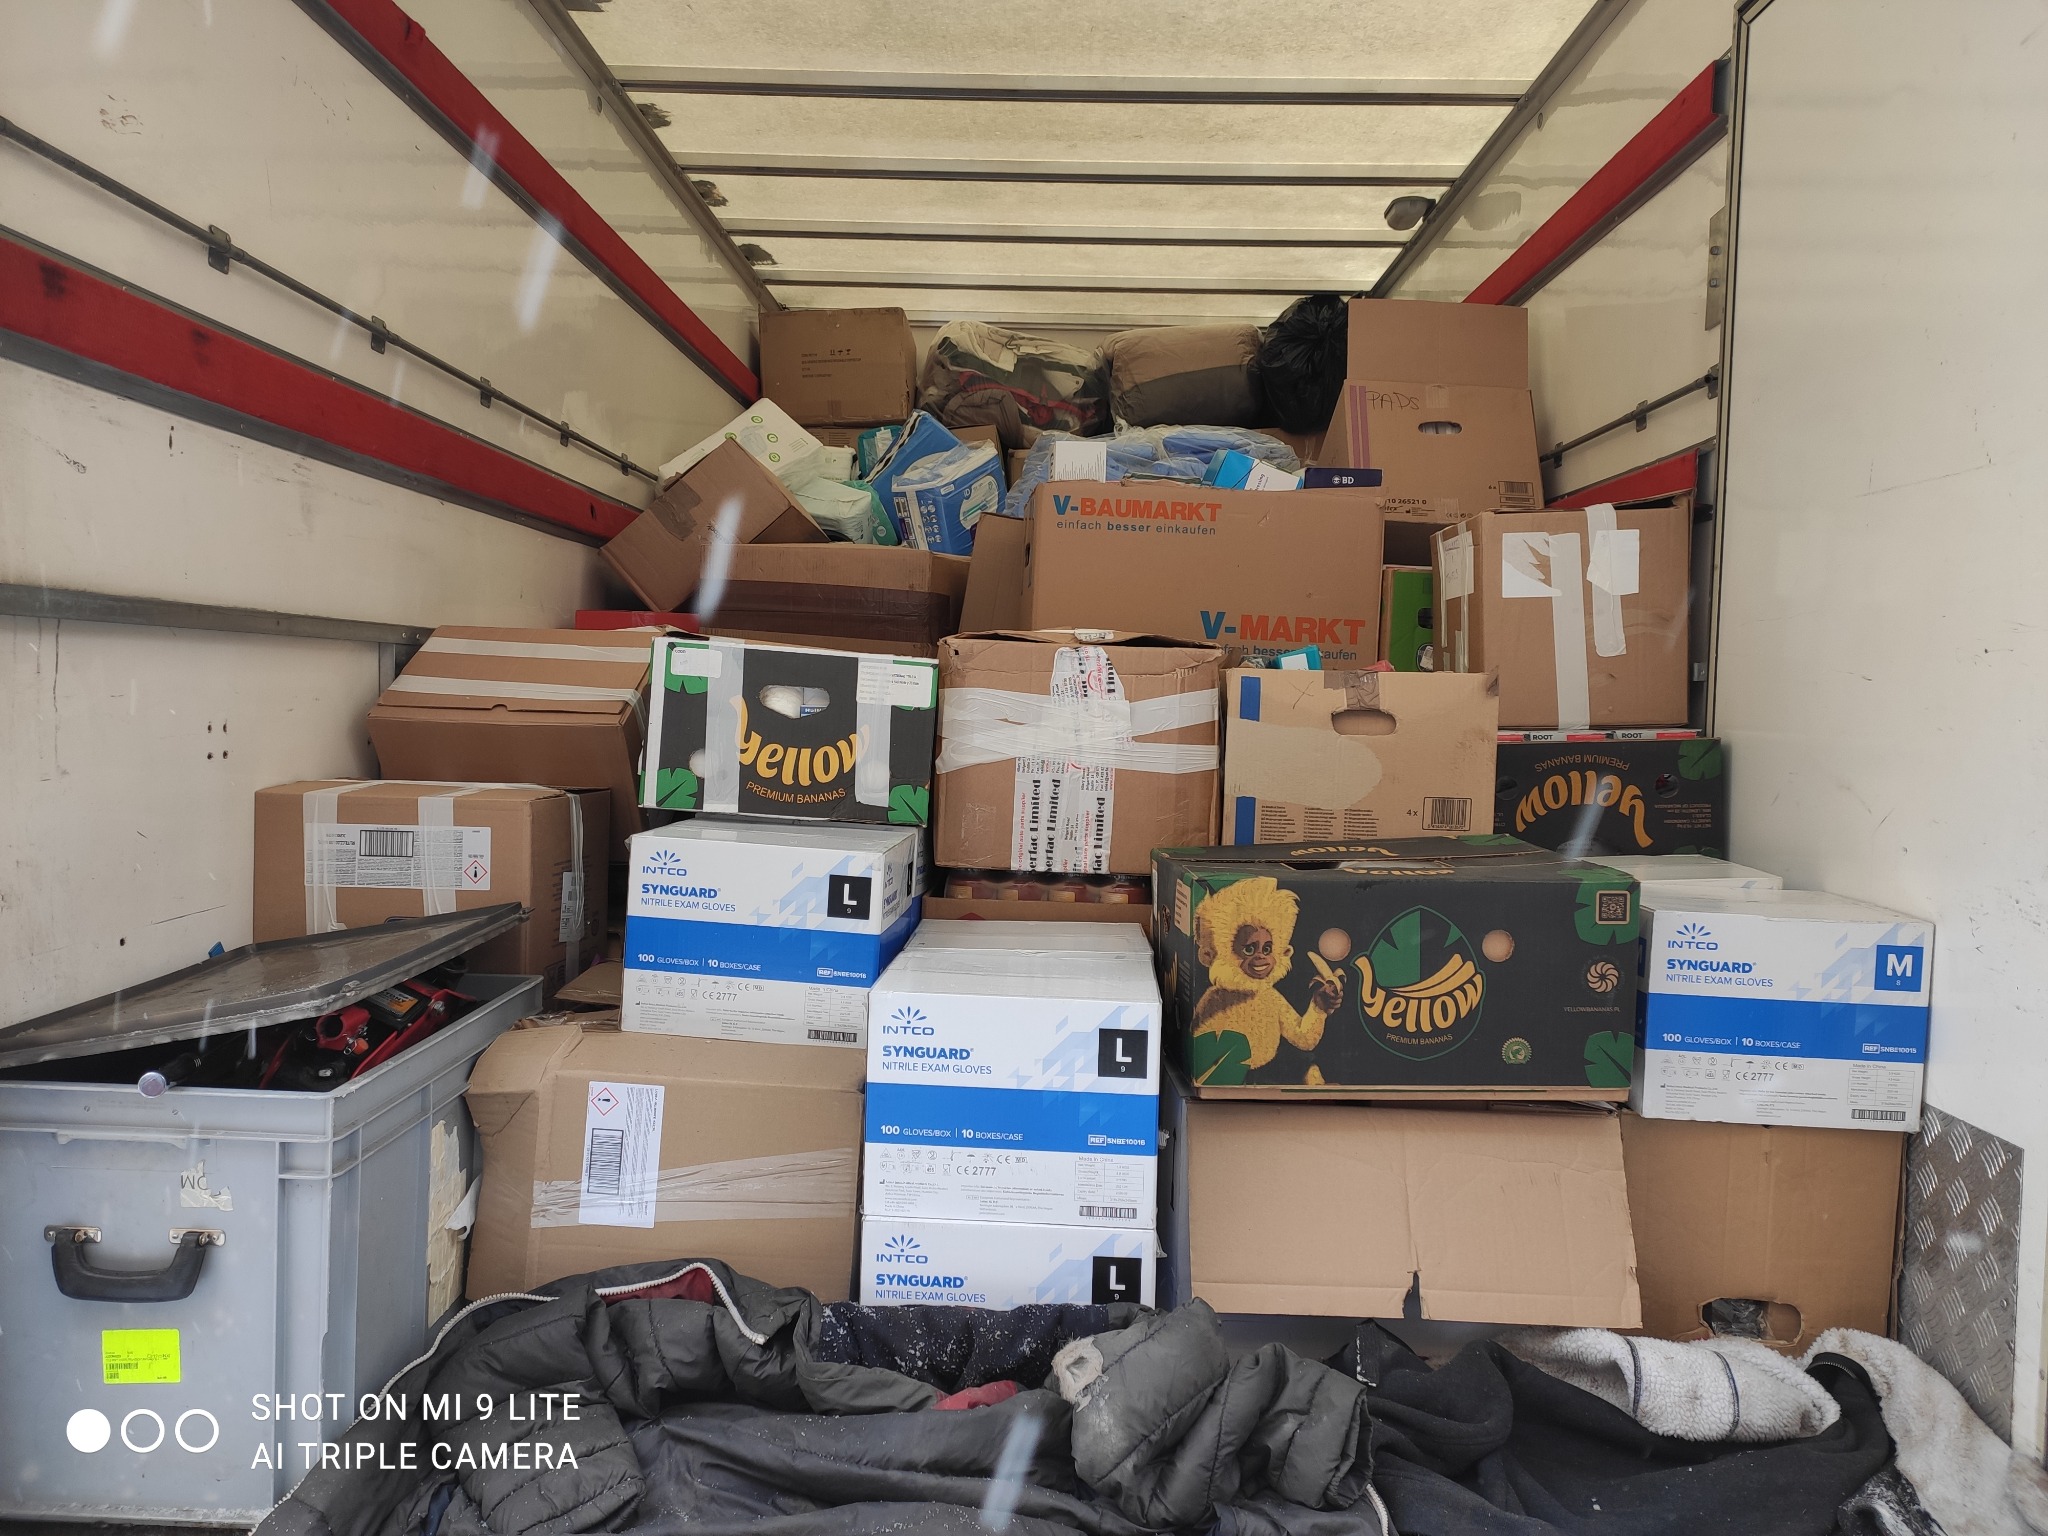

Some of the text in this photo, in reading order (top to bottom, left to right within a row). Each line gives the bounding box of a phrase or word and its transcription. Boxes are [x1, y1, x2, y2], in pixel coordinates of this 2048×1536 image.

[1365, 390, 1420, 411] PADS
[1342, 476, 1355, 485] BD
[1052, 494, 1223, 522] V-BAUMARKT
[1056, 518, 1217, 536] einfach besser einkaufen
[1200, 610, 1366, 645] V-MARKT
[1534, 754, 1631, 773] PREMIUM BANANAS
[745, 780, 846, 804] PREMIUM BANANAS
[1028, 779, 1042, 832] Limited
[1045, 779, 1061, 832] Limited
[1515, 770, 1654, 849] yellow
[1094, 796, 1106, 849] Limited
[642, 865, 687, 876] INTCO
[843, 883, 857, 905] L
[640, 897, 736, 912] NITRILE EXAM GLOVES
[1667, 939, 1718, 951] INTCO
[637, 954, 699, 967] 100 GLOVES/BOX
[707, 959, 761, 972] 10 BOXES/CASE
[1886, 953, 1913, 978] M
[1666, 973, 1773, 988] NITRILE EXAM GLOVES
[716, 991, 737, 1002] 2777
[1354, 956, 1485, 1034] yellow
[882, 1025, 934, 1036] INTCO
[1386, 1032, 1454, 1046] PREMIUM BANANAS
[1662, 1033, 1732, 1046] 100 GLOVES/BOX
[1741, 1037, 1802, 1050] 10 BOXES/CASE
[1116, 1037, 1132, 1063] L
[1864, 1045, 1879, 1053] REF
[882, 1061, 992, 1075] NITRILE EXAM GLOVES
[1750, 1072, 1775, 1082] 2777
[880, 1125, 951, 1138] 100 GLOVES/BOX
[961, 1129, 1023, 1142] 10 BOXES/CASE
[972, 1166, 996, 1176] 2777
[876, 1253, 928, 1264] INTCO
[1110, 1265, 1126, 1291] L
[875, 1289, 986, 1303] NITRILE EXAM GLOVES
